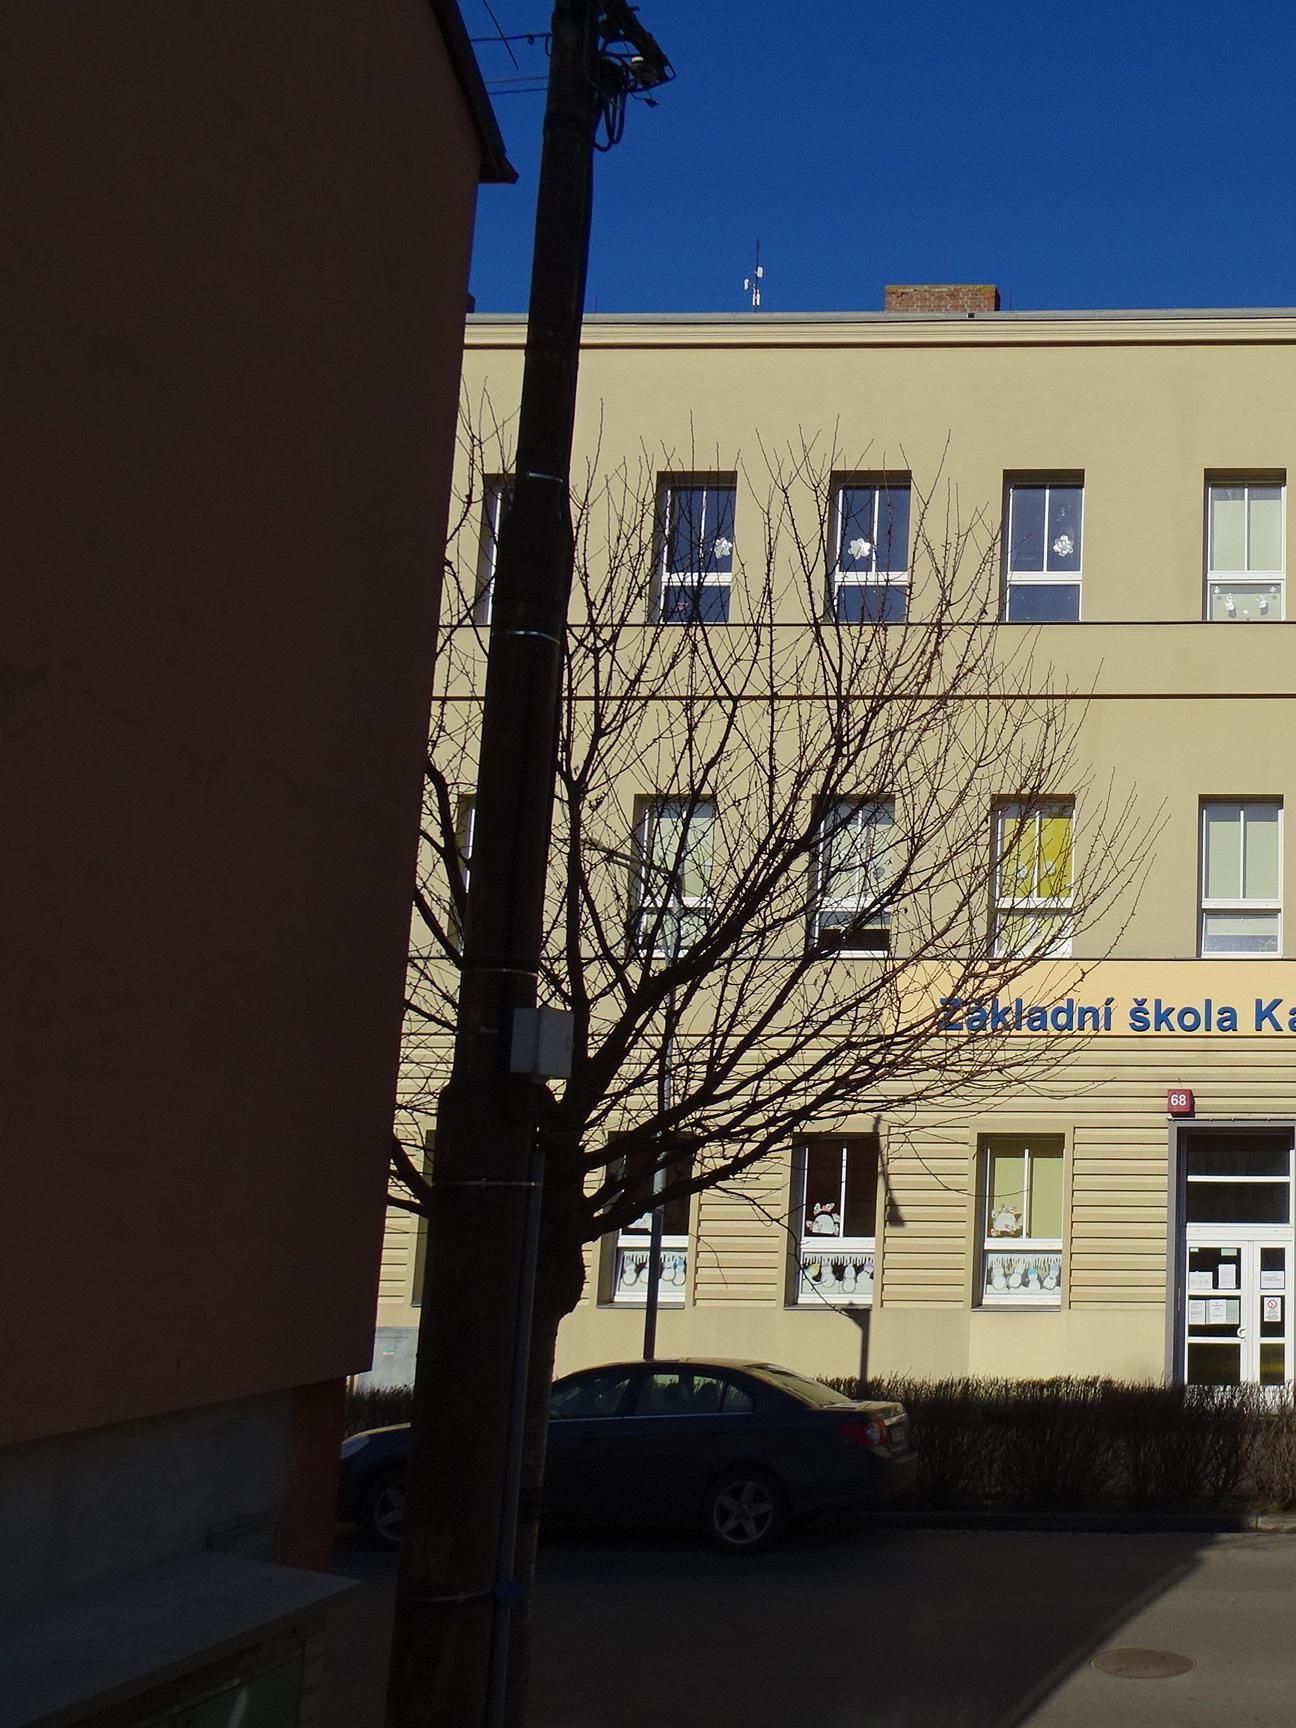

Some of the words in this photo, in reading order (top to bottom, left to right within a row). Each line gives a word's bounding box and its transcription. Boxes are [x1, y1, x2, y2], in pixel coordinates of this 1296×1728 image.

[939, 997, 1114, 1032] Základní
[1128, 997, 1238, 1032] škola
[1170, 1094, 1187, 1106] 68
